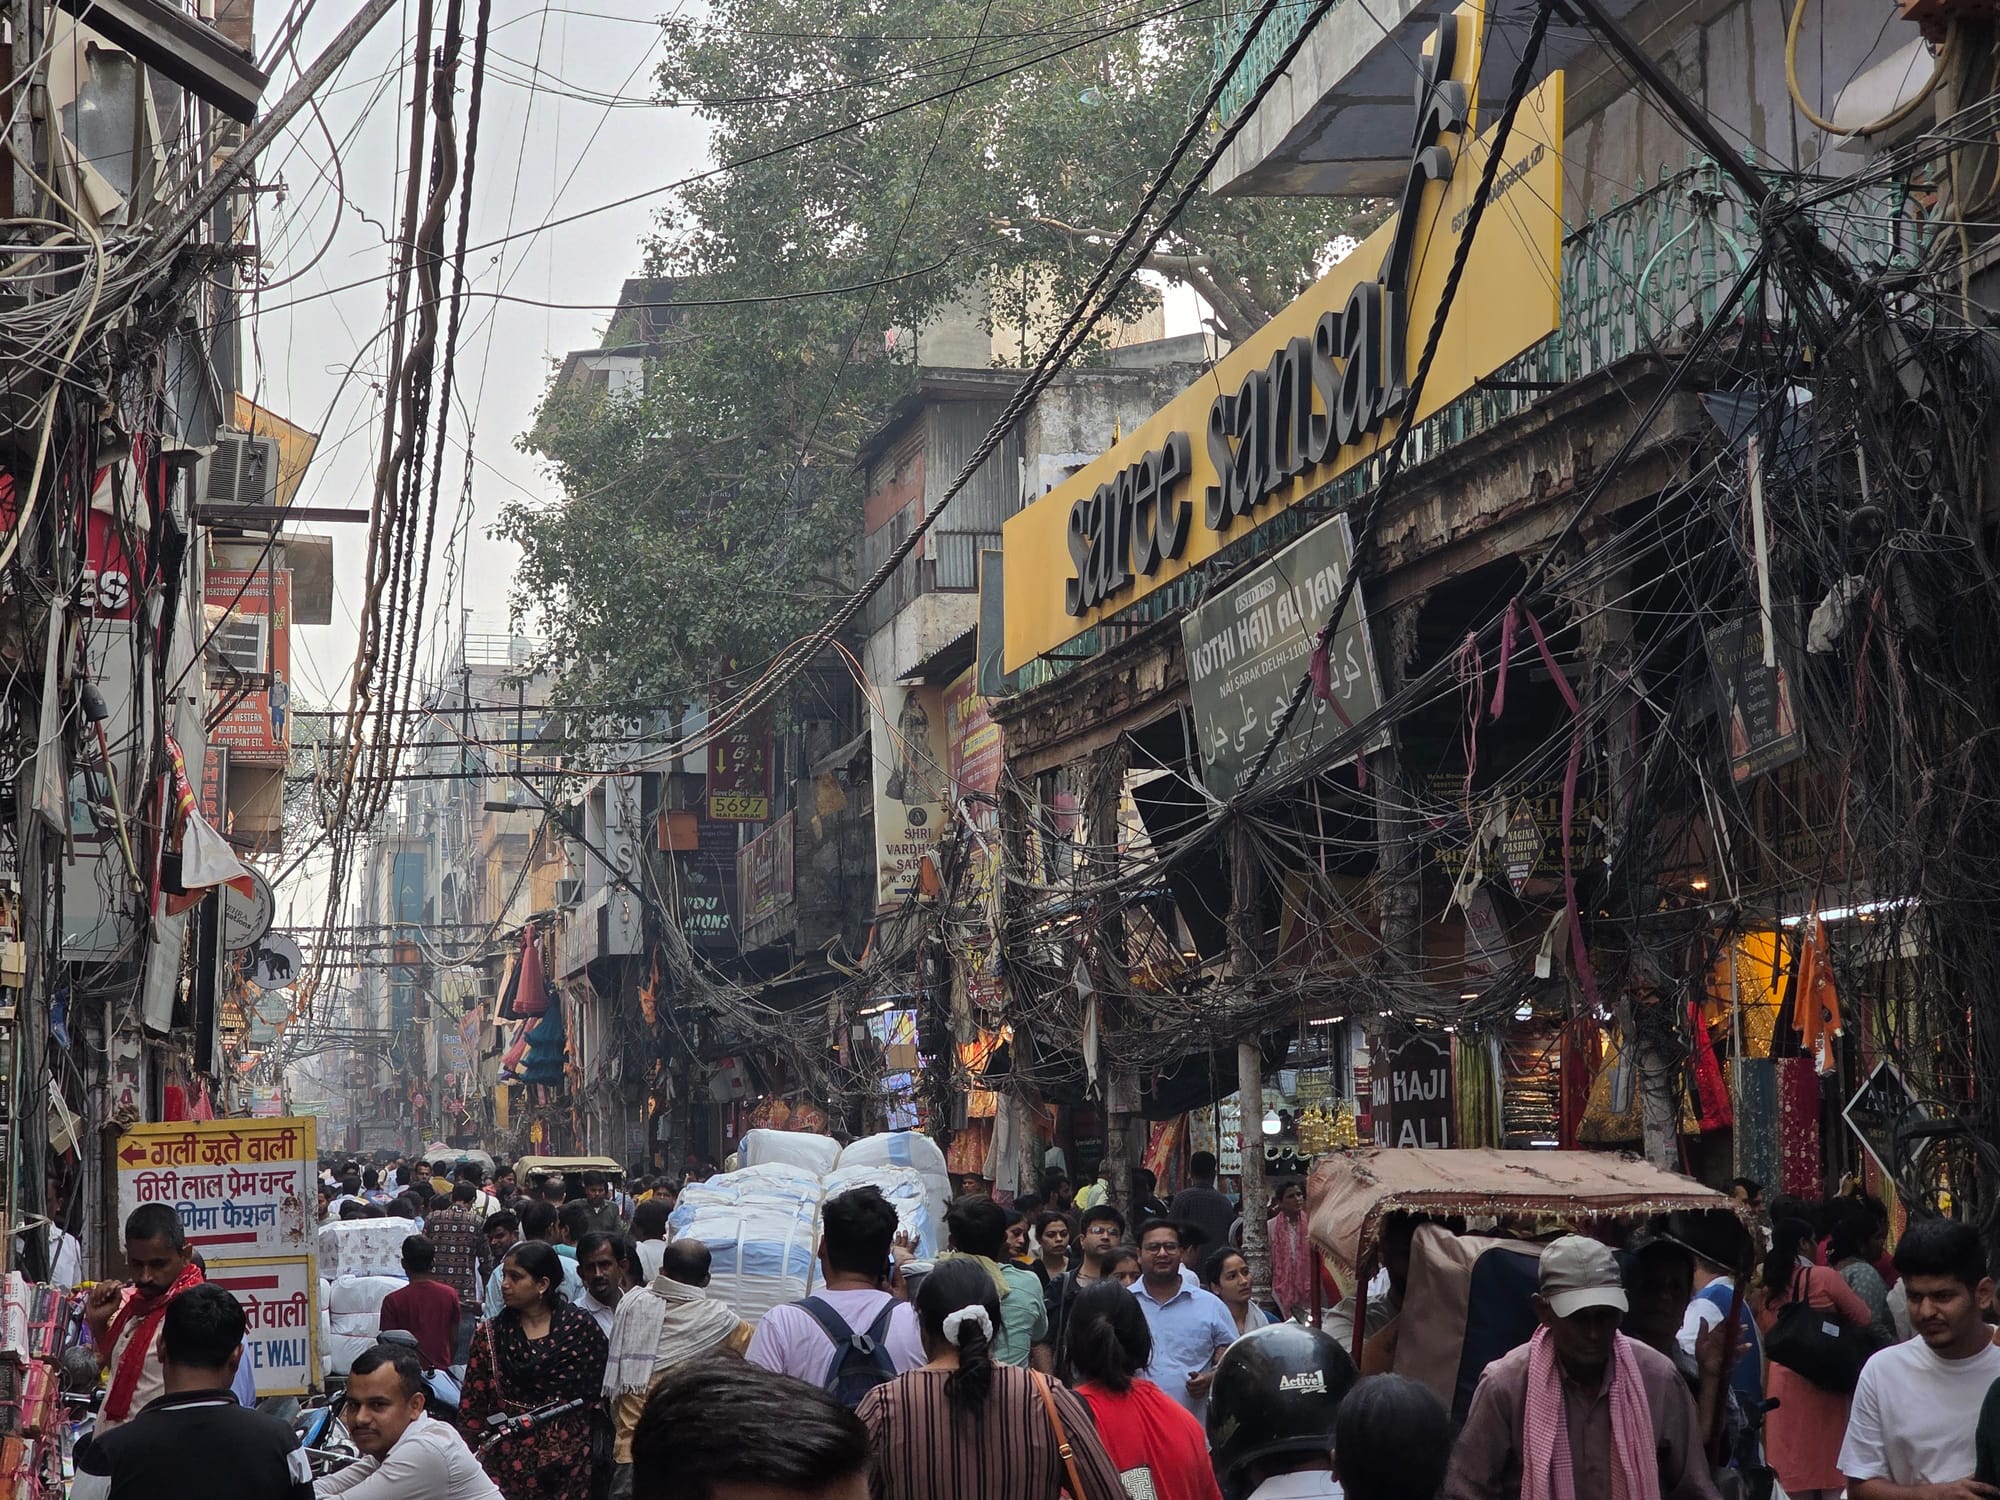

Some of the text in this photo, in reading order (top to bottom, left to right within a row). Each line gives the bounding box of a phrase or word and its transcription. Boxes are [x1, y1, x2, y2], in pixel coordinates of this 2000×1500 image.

[1066, 431, 1193, 617] saree
[1192, 561, 1343, 682] KOTHI HAJI ALI JAN
[1219, 682, 1234, 698] NAI
[1234, 664, 1261, 690] SARAK
[715, 798, 763, 813] 5697
[904, 828, 932, 840] SHRI
[1502, 839, 1539, 854] FASHION
[1507, 829, 1535, 841] NAGINA
[896, 859, 920, 872] SAR
[1507, 852, 1532, 862] GLOBAL
[1372, 1077, 1389, 1106] HAJI
[1393, 1069, 1446, 1102] HAJI
[150, 1128, 297, 1166] गली जूते वाली
[1374, 1120, 1390, 1147] ALI
[1397, 1117, 1448, 1149] ALI
[133, 1167, 297, 1202] गिरी लाल प्रेम चन्द
[221, 1199, 278, 1228] फैशन
[263, 1291, 308, 1329] वाली
[266, 1338, 306, 1367] WALI
